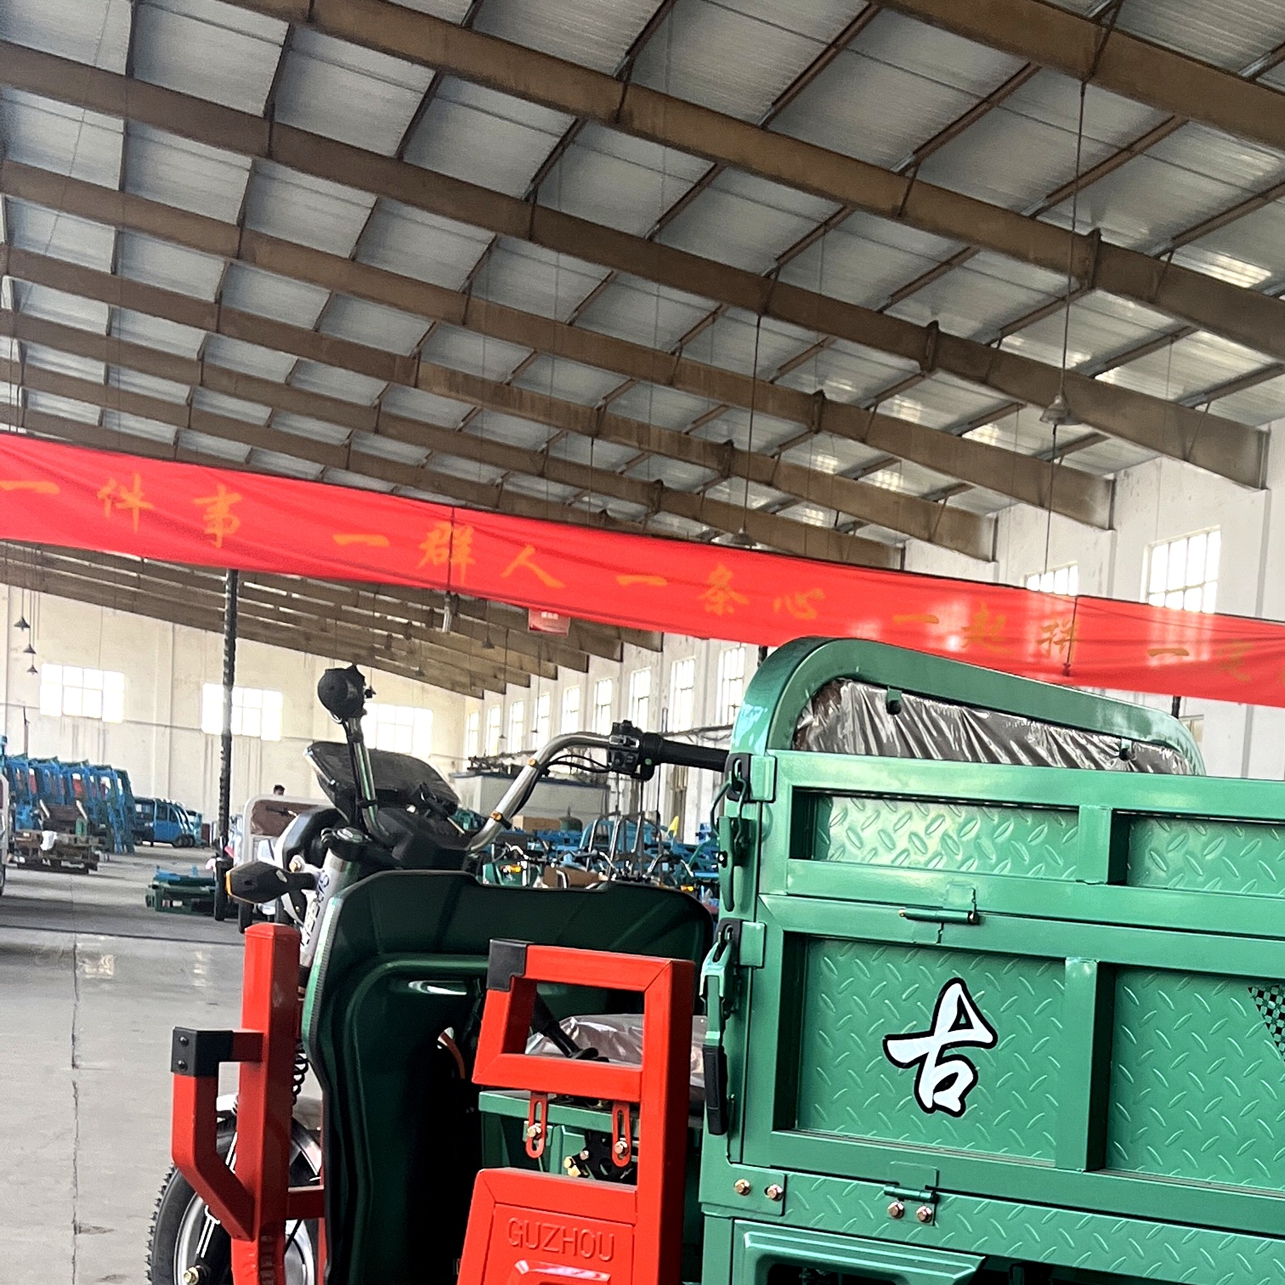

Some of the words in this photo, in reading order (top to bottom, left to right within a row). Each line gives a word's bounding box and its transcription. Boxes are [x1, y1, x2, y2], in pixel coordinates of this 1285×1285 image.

[0, 473, 242, 548] 一件事
[332, 522, 565, 588] 一群人
[616, 562, 825, 620] 一条心
[883, 977, 998, 1118] 古
[507, 1216, 616, 1262] GUZHOU
